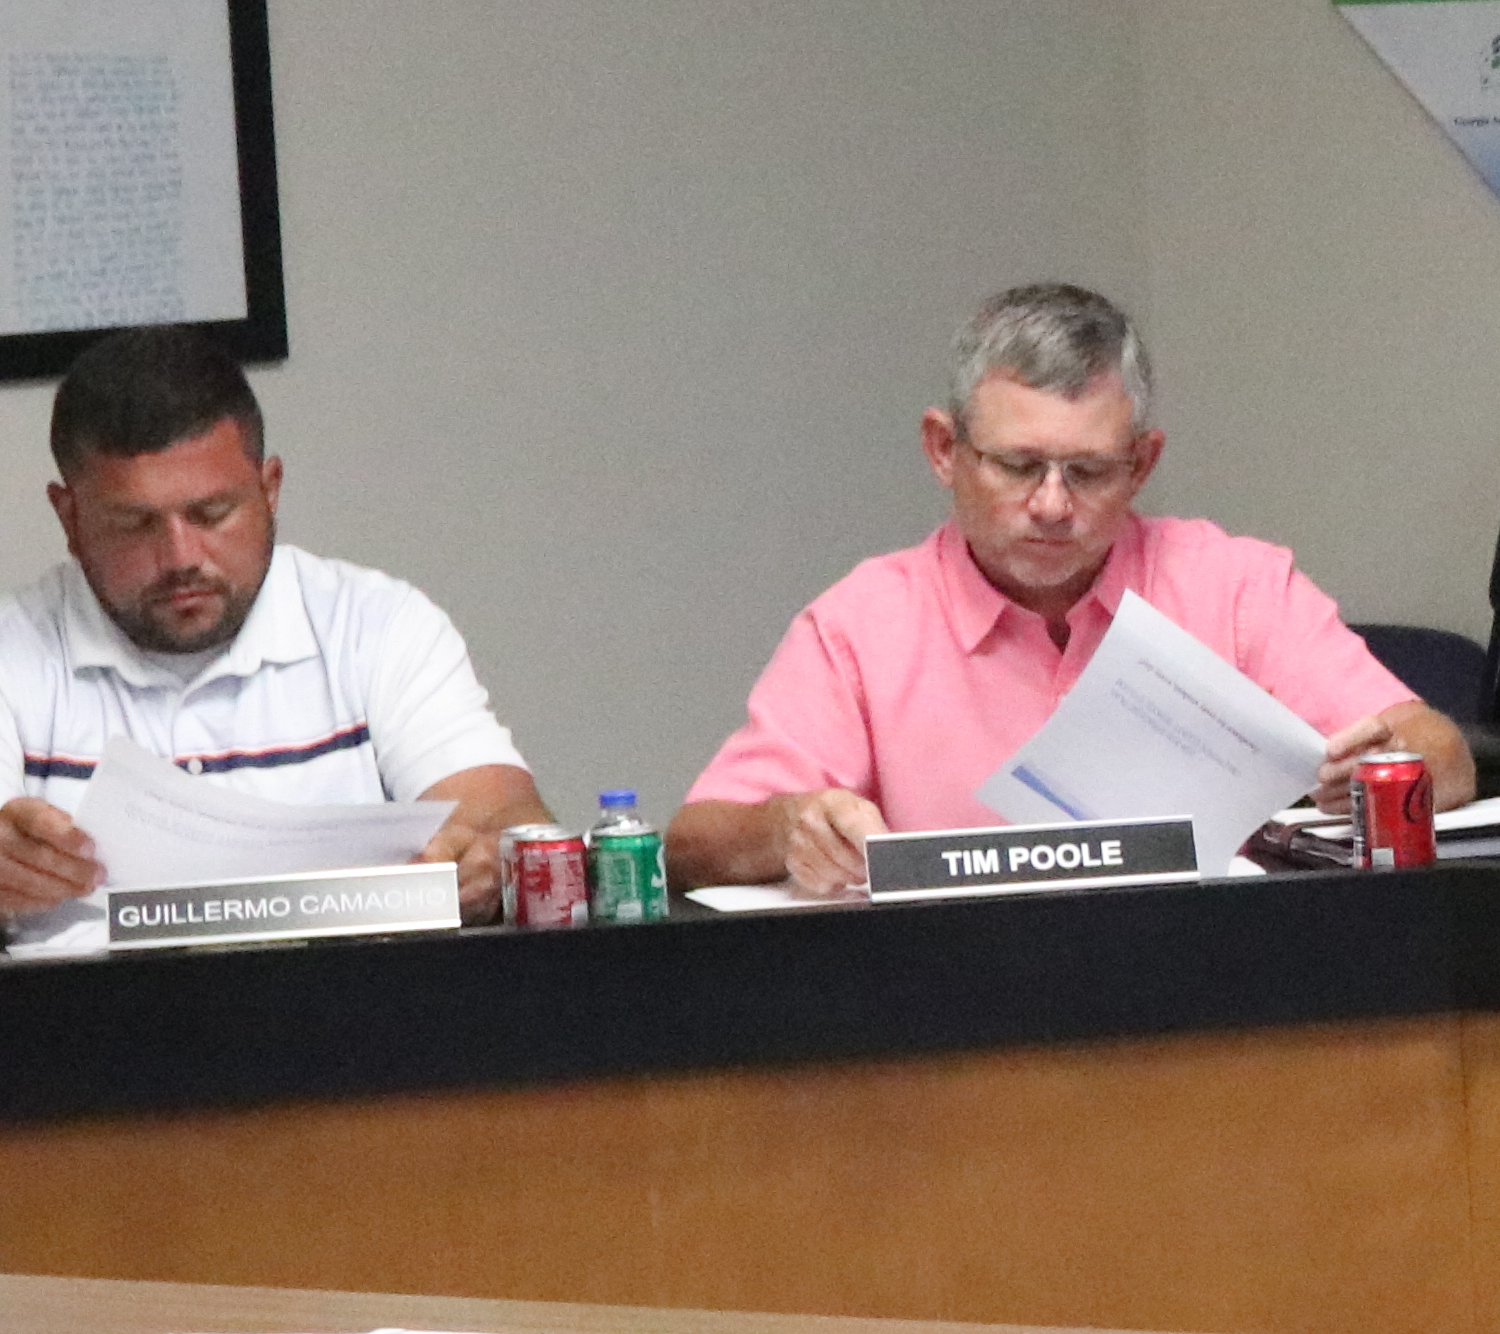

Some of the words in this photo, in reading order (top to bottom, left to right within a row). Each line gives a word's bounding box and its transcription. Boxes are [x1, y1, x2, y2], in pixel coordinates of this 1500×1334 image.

[941, 848, 999, 877] TIM
[1008, 840, 1123, 872] POOLE
[118, 897, 290, 928] GUILLERMO
[299, 886, 447, 914] CAMACHO
